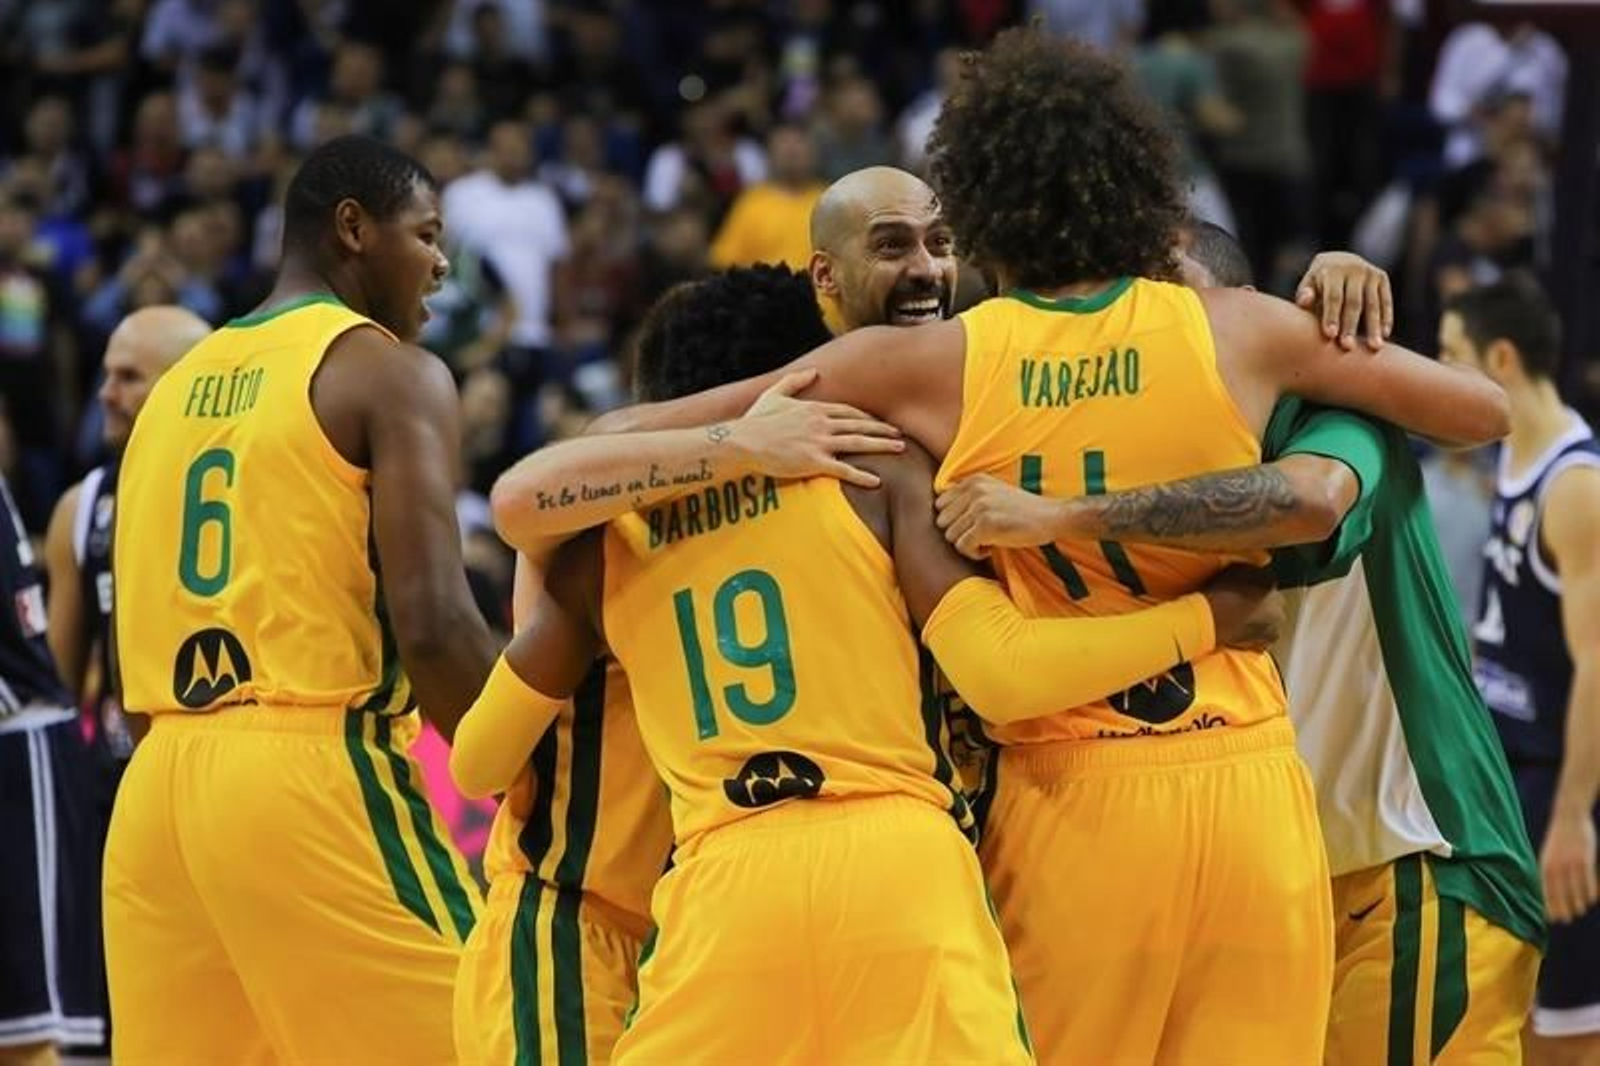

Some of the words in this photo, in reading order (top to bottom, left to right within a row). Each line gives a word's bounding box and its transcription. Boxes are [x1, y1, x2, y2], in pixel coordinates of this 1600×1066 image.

[178, 448, 235, 598] 6
[626, 478, 646, 493] en
[648, 474, 781, 549] BARBOSA
[672, 568, 798, 741] 19
